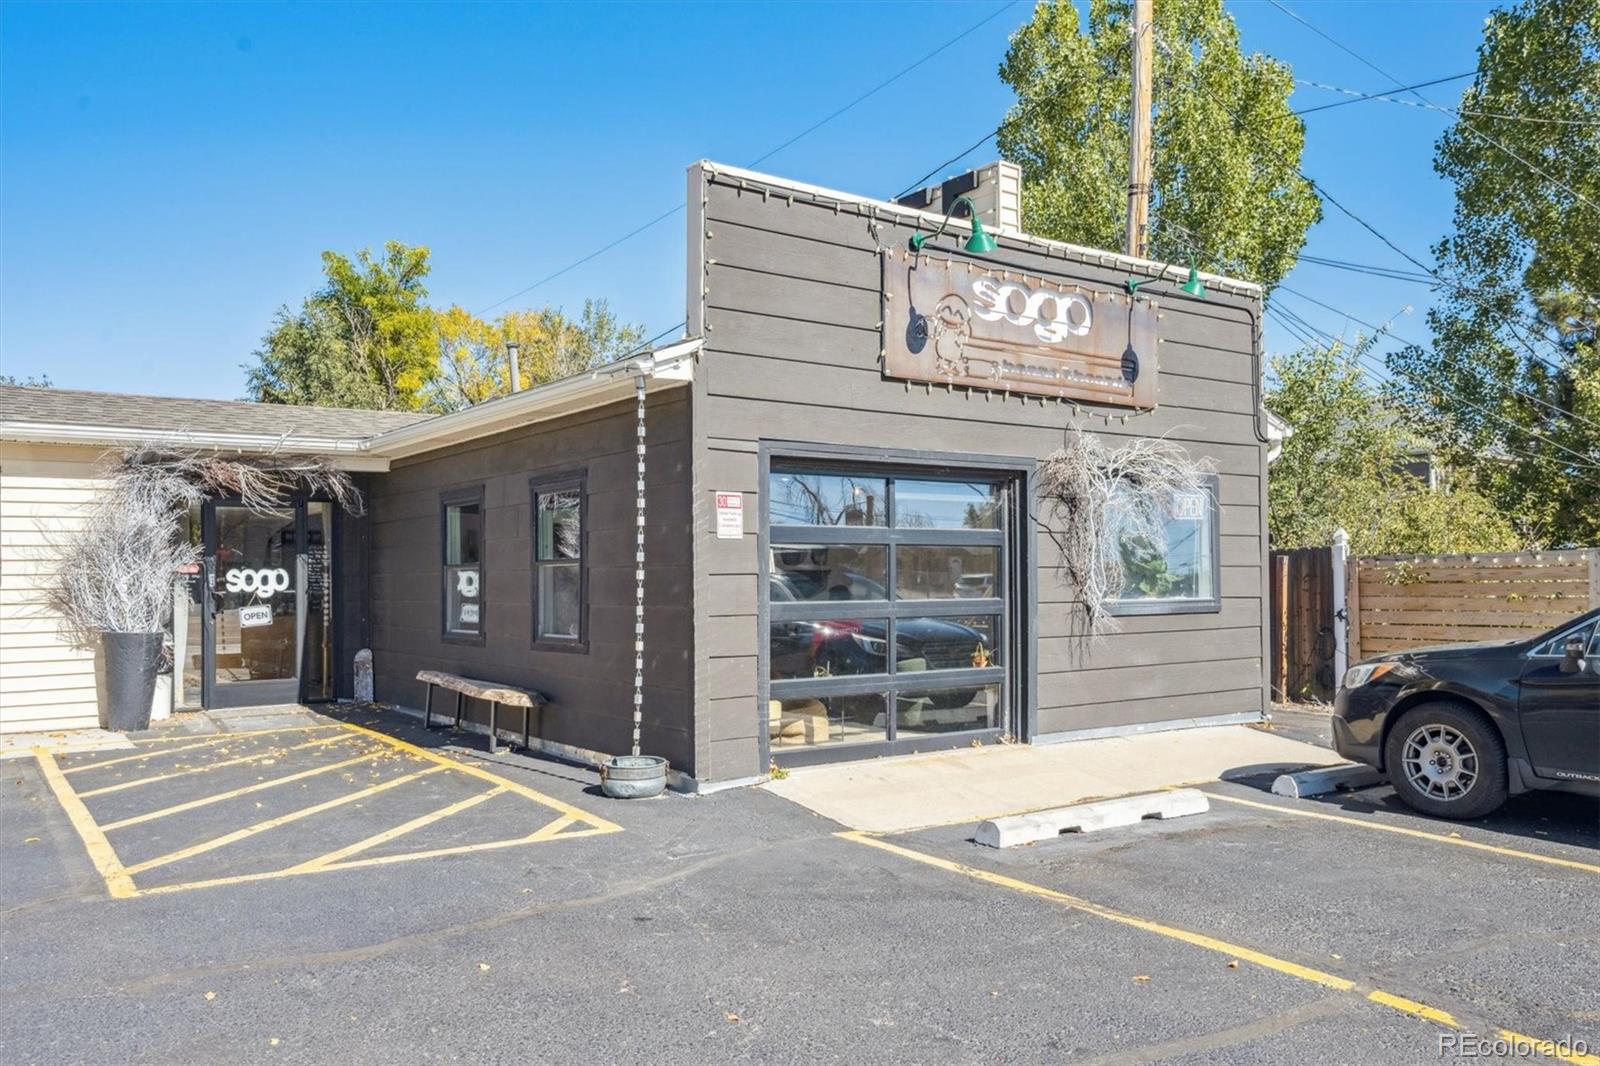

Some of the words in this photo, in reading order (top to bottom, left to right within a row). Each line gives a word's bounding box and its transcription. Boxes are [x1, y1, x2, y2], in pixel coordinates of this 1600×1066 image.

[972, 277, 1092, 343] sogo
[225, 568, 289, 598] sogo
[243, 611, 268, 621] OPEN
